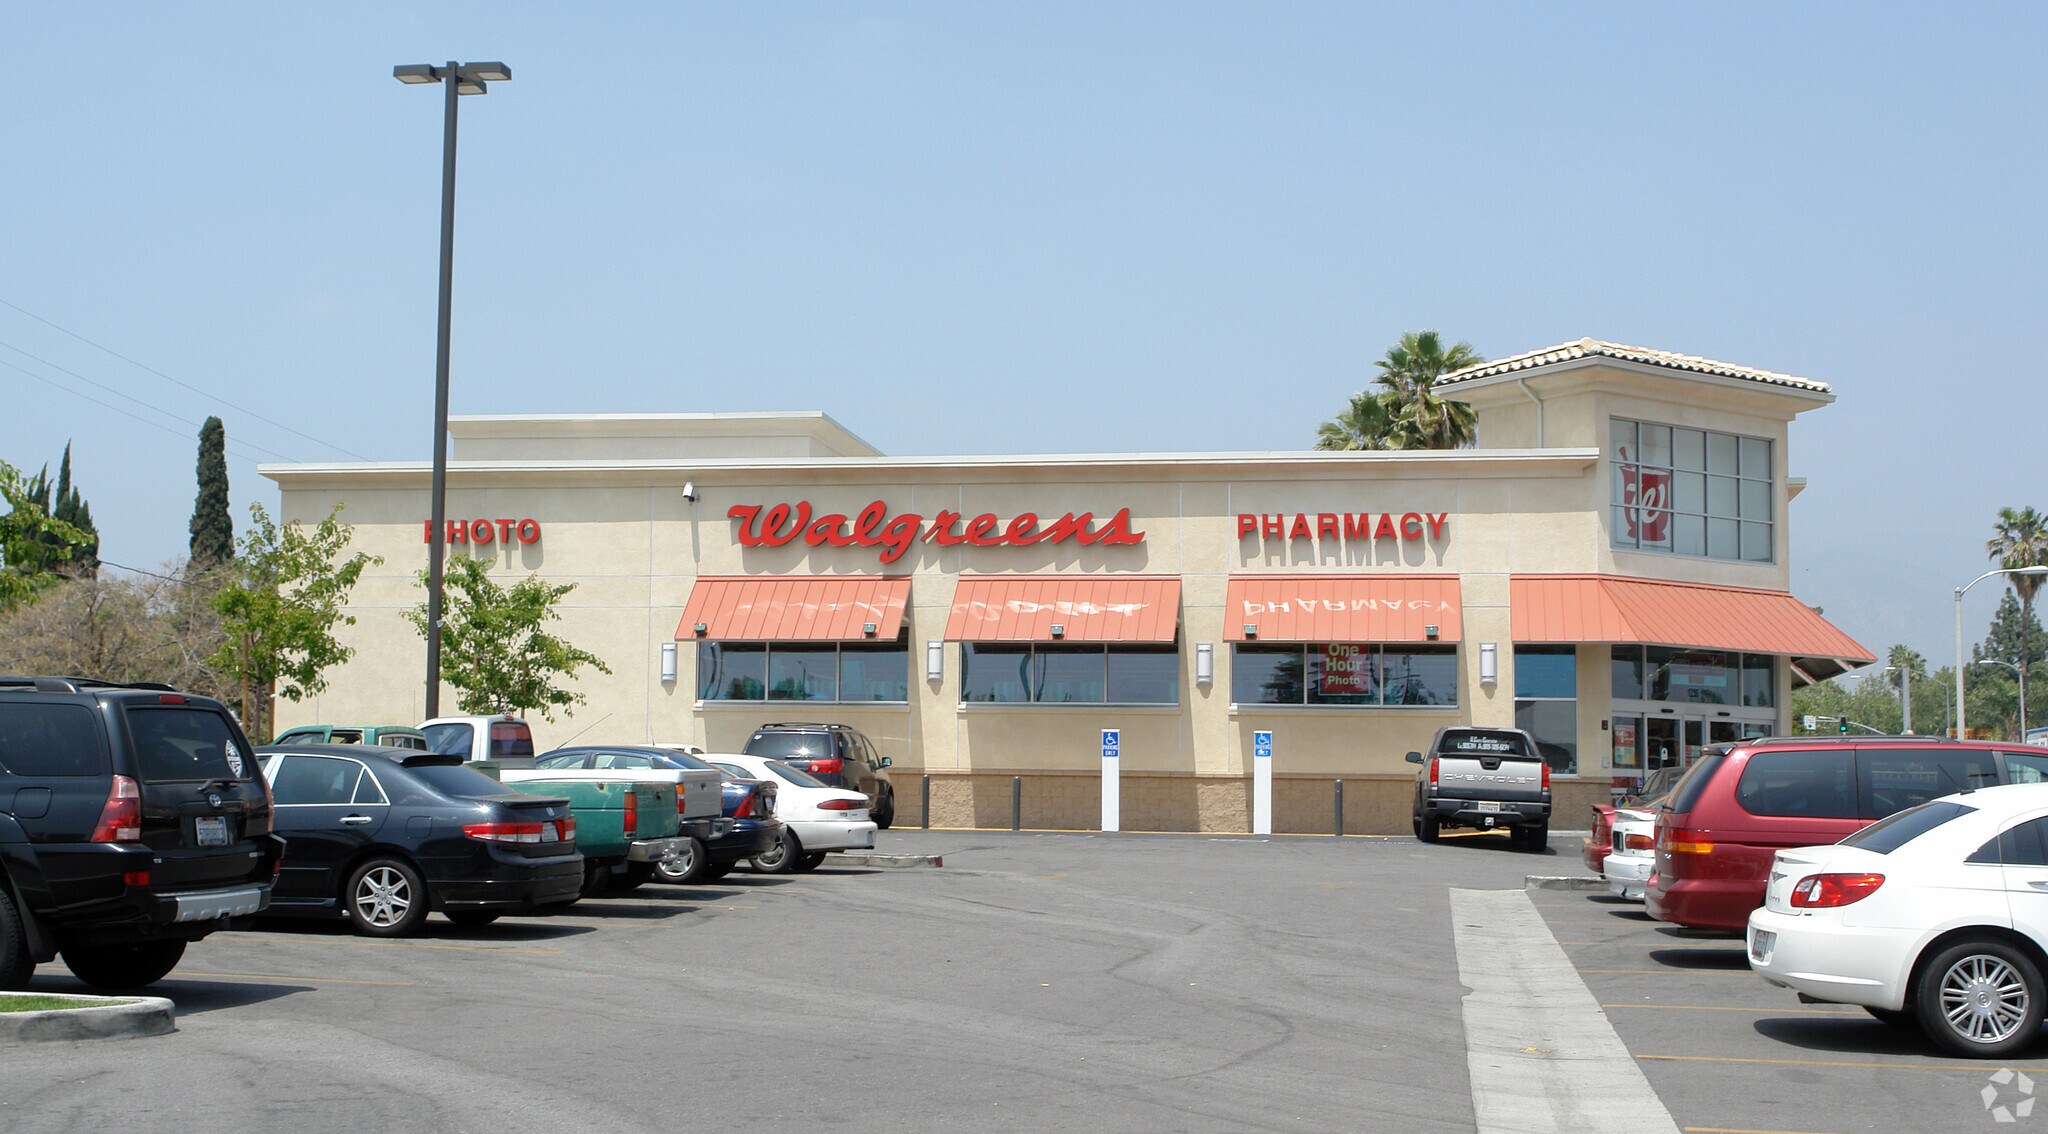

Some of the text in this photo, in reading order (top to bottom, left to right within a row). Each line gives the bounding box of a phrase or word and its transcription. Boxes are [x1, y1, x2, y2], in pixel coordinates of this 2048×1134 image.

[727, 500, 1146, 564] Walgreens
[1237, 512, 1449, 540] PHARMACY
[1328, 642, 1360, 657] One
[1325, 657, 1362, 672] Hour
[1327, 675, 1361, 685] Photo
